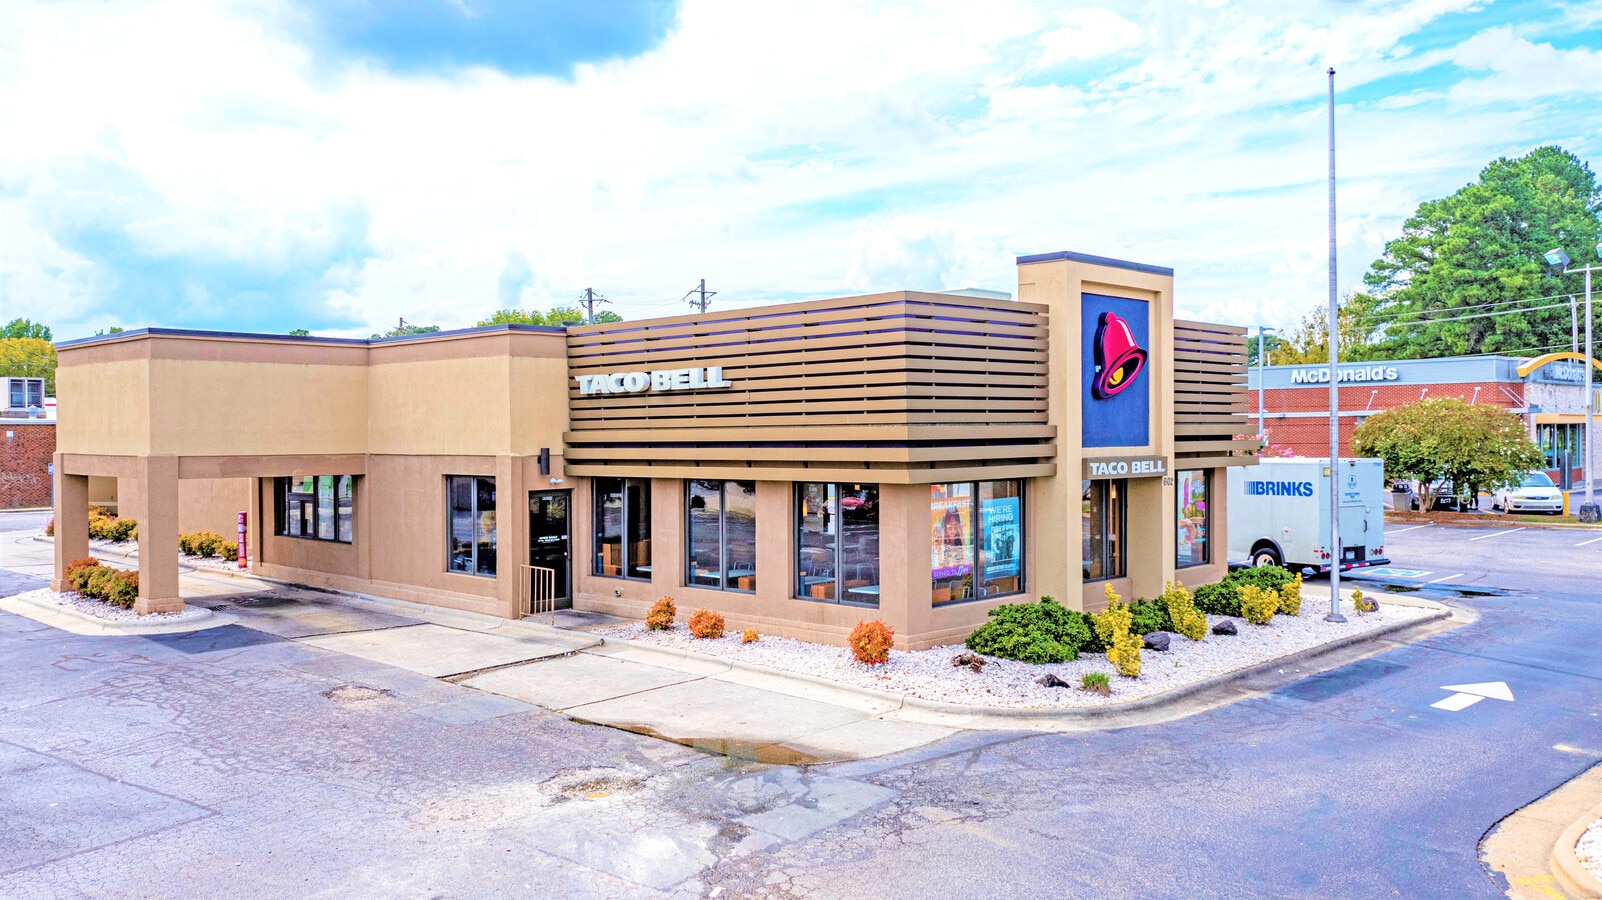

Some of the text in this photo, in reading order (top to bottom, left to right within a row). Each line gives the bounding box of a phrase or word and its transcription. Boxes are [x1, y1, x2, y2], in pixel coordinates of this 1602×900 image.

[575, 366, 732, 395] TACO BELL
[1089, 460, 1166, 476] TACO BELL
[1163, 477, 1174, 486] 602
[1255, 480, 1314, 497] BRINKS
[987, 513, 1014, 523] HIRING
